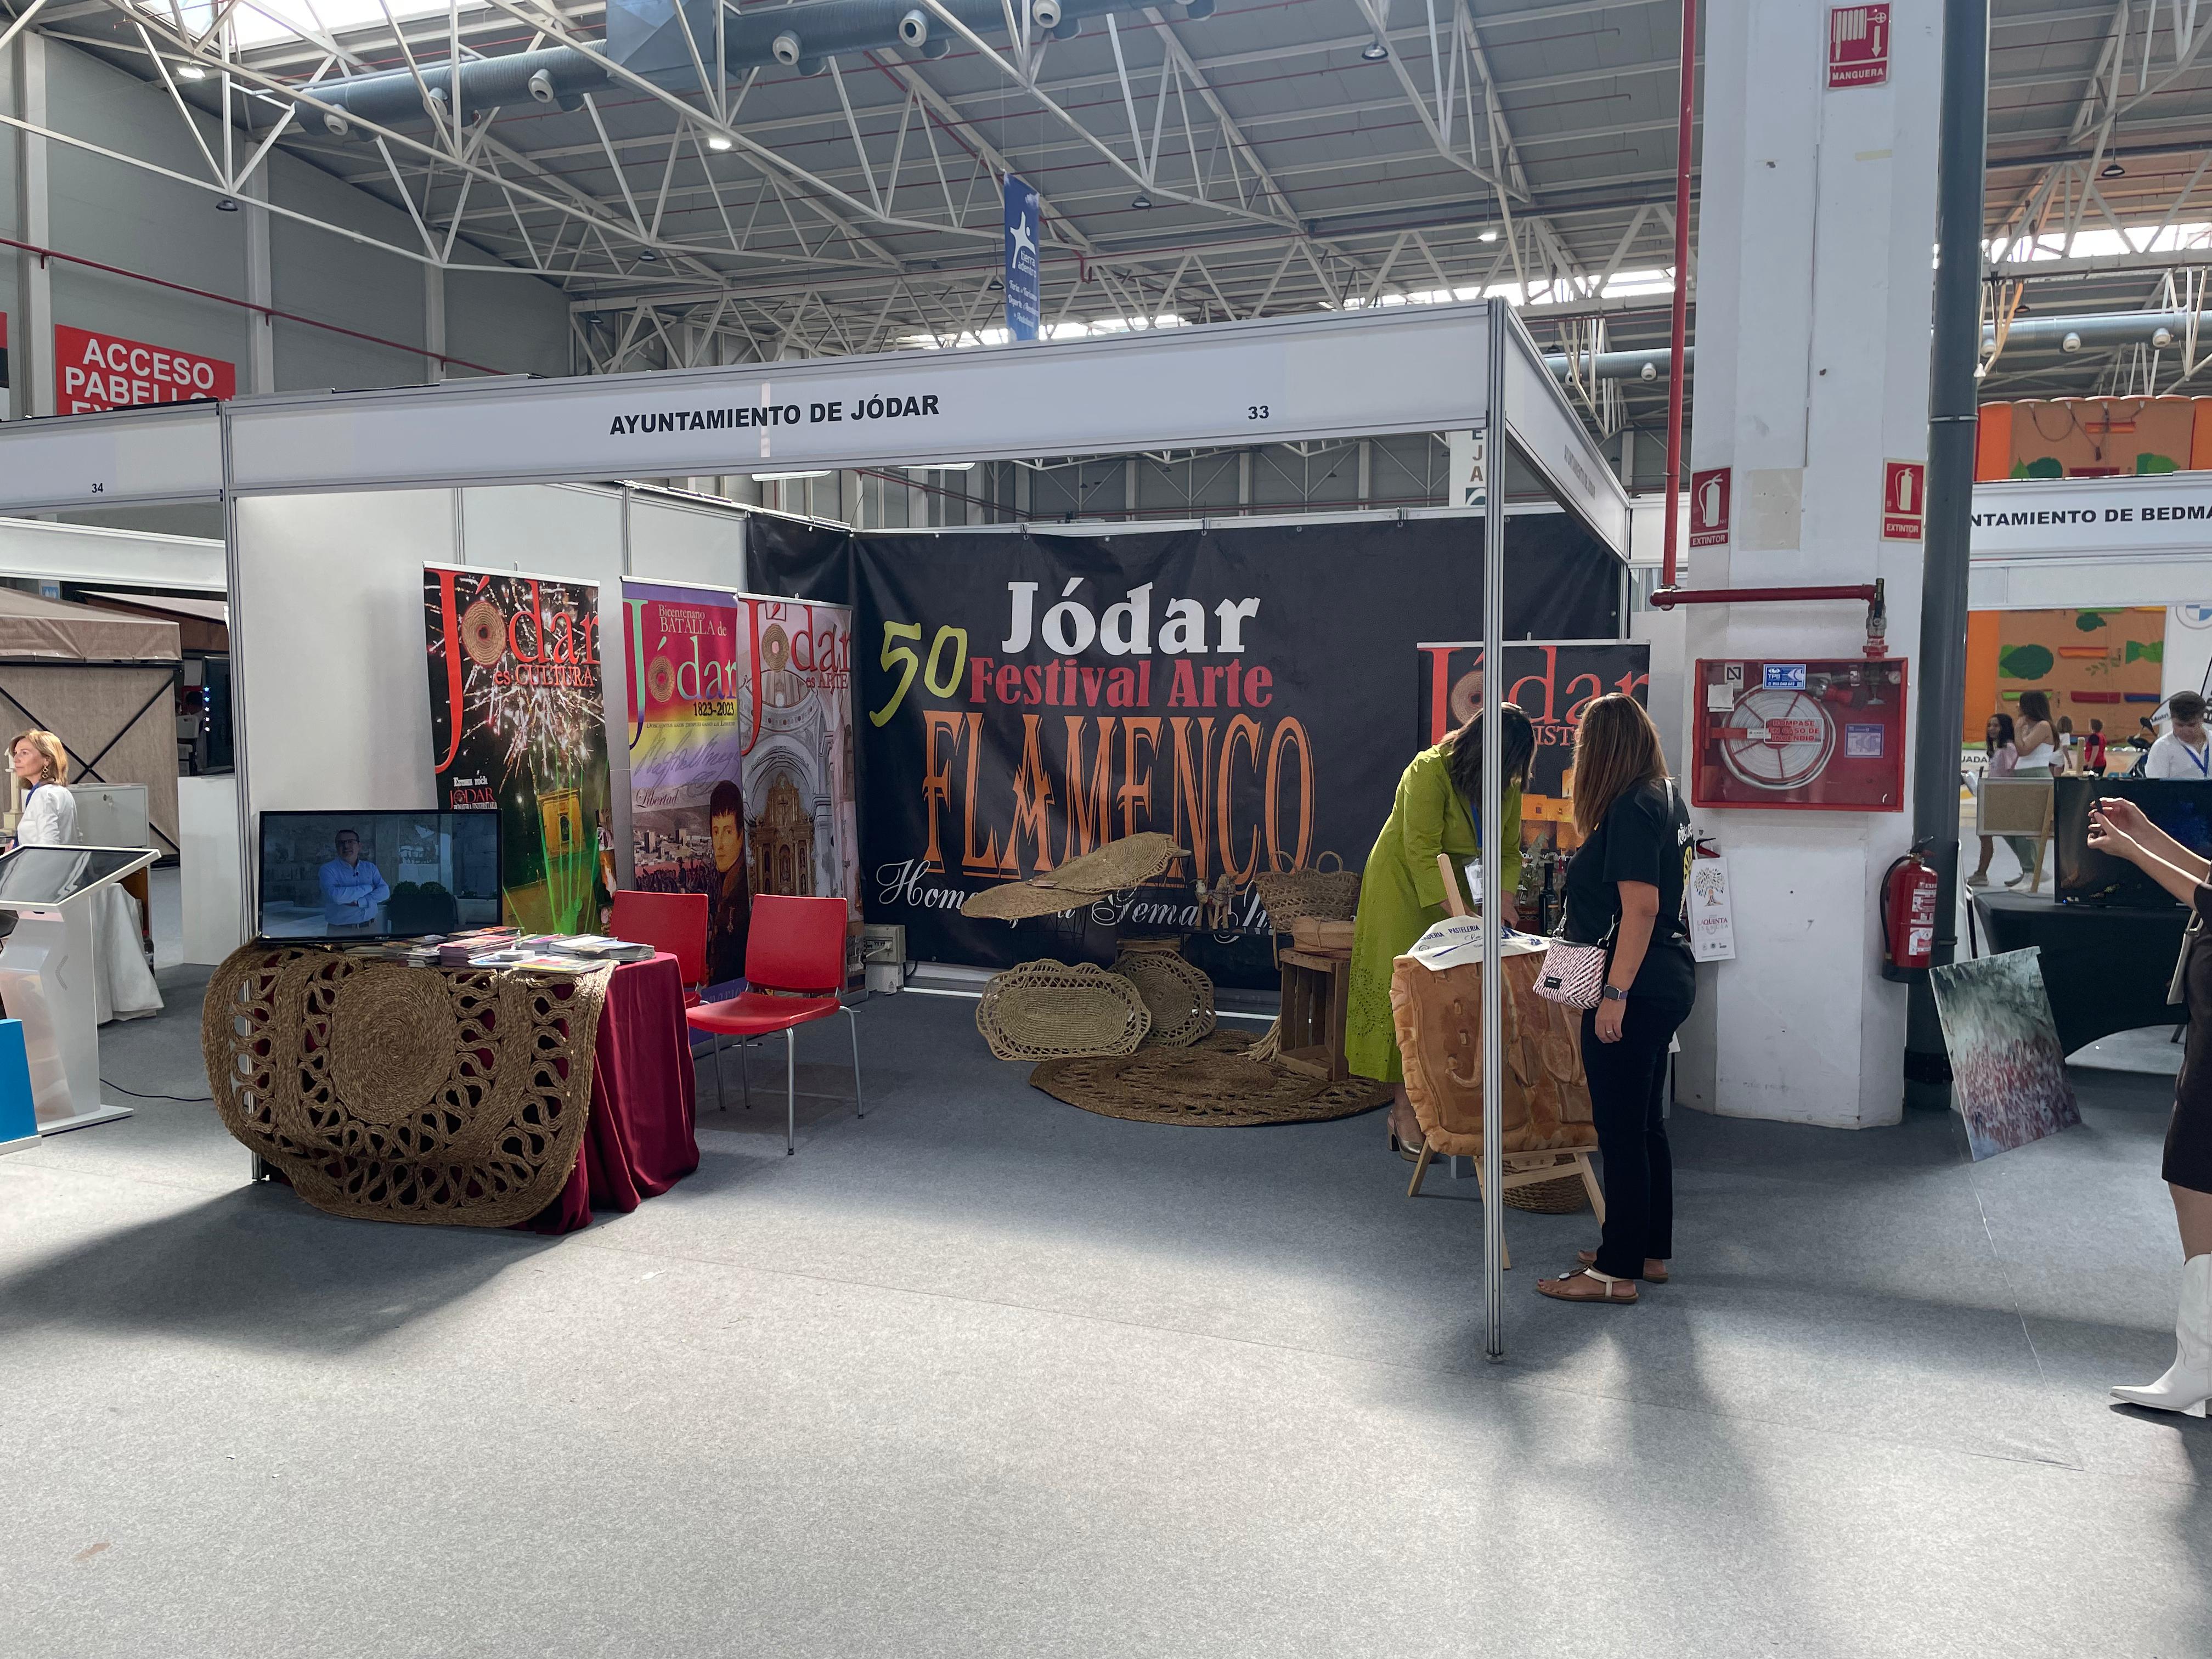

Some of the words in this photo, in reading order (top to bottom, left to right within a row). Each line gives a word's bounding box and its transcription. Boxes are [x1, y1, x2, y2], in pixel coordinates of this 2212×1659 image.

[1832, 67, 1883, 80] MANGUERA
[1020, 250, 1035, 267] tierra
[82, 338, 214, 390] ACCESO
[610, 404, 801, 435] AYUNTAMIENTO
[810, 401, 843, 423] DE
[850, 393, 940, 420] JÓDAR
[1248, 405, 1269, 420] 33
[92, 482, 104, 493] 34
[1971, 510, 2097, 527] NTAMIENTO
[2104, 508, 2133, 523] DE
[1886, 523, 1918, 533] EXTINTOR
[1692, 534, 1725, 545] EXTINTOR
[658, 604, 705, 619] Bicentenario
[1001, 577, 1261, 656] Jódar
[660, 617, 715, 636] BATALLA
[718, 621, 727, 636] de
[494, 669, 511, 685] es
[515, 664, 595, 687] CULTURA
[805, 676, 816, 688] es
[817, 672, 848, 690] ARTE
[868, 620, 968, 728] 50
[968, 657, 1152, 707] Festival
[1167, 658, 1274, 708] Arte
[693, 702, 735, 716] 1823-2023
[635, 787, 679, 808] Libertad
[922, 710, 1316, 890] FLAMENCO
[1448, 924, 1480, 934] PASTELERIA
